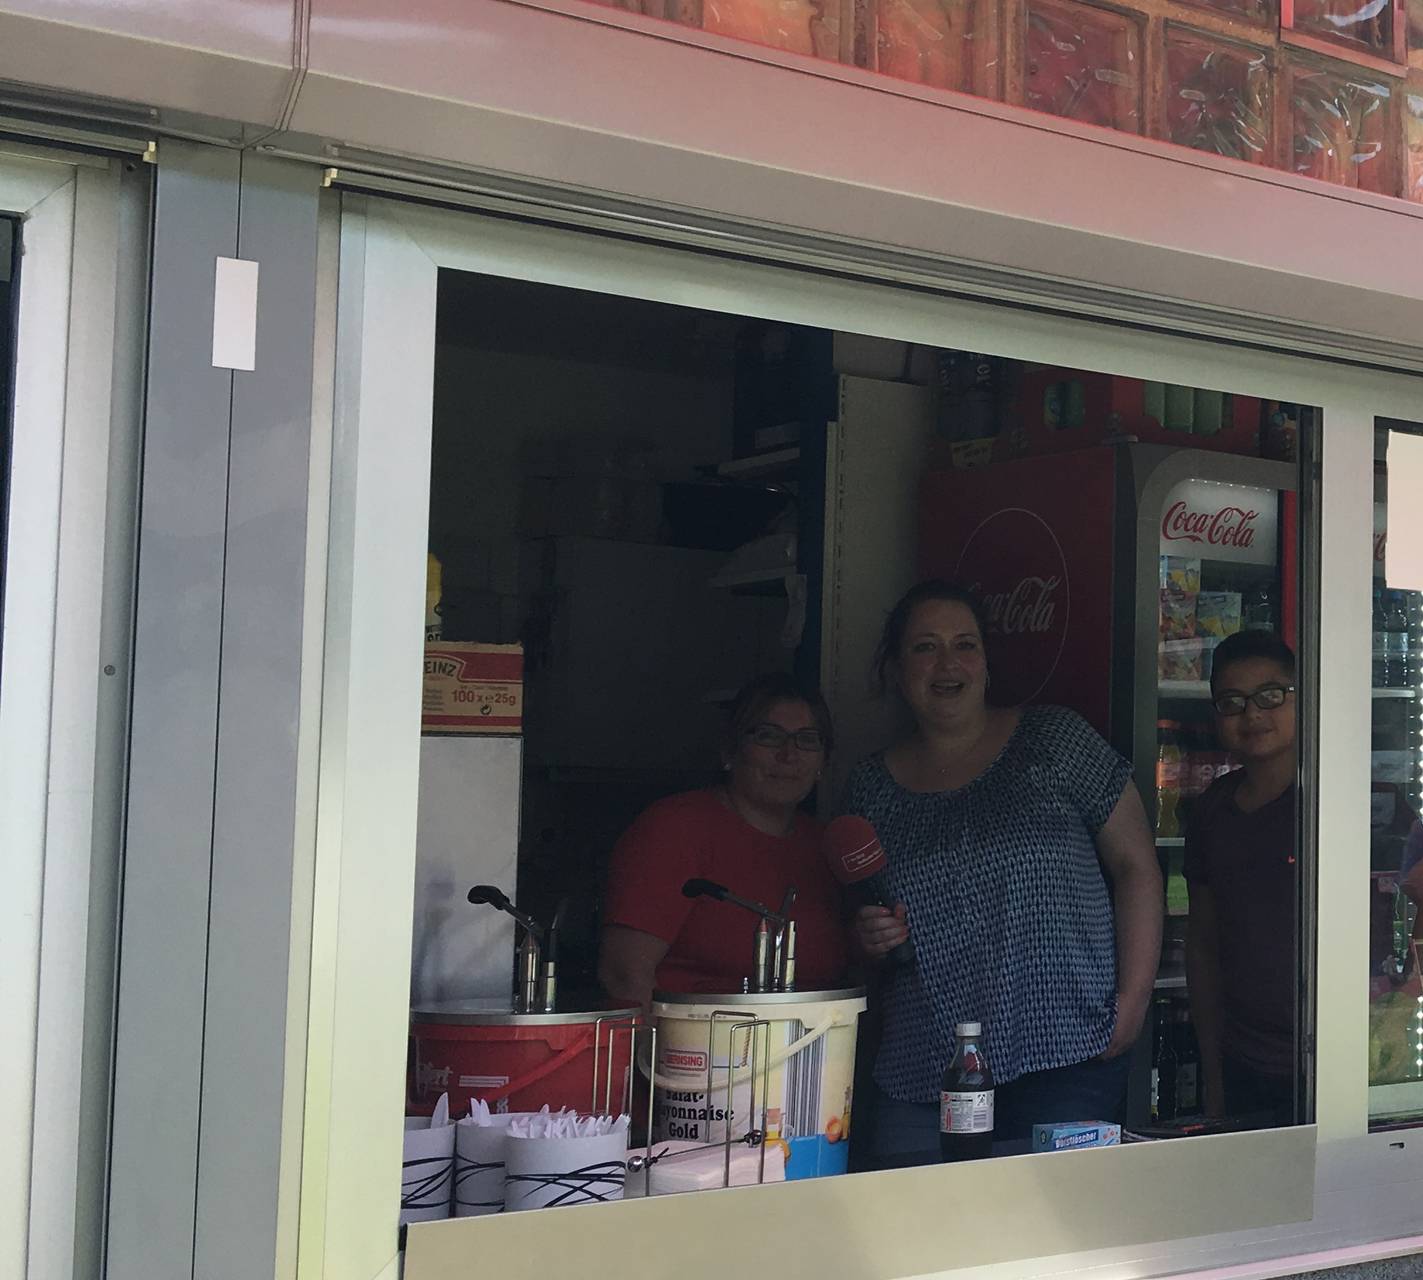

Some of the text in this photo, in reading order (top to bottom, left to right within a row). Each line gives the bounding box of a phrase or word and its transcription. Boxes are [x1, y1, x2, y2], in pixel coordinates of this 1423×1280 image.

[1162, 500, 1259, 548] Coca-Cola
[423, 660, 457, 677] EINZ
[451, 689, 475, 703] 100
[669, 1122, 700, 1140] Gold
